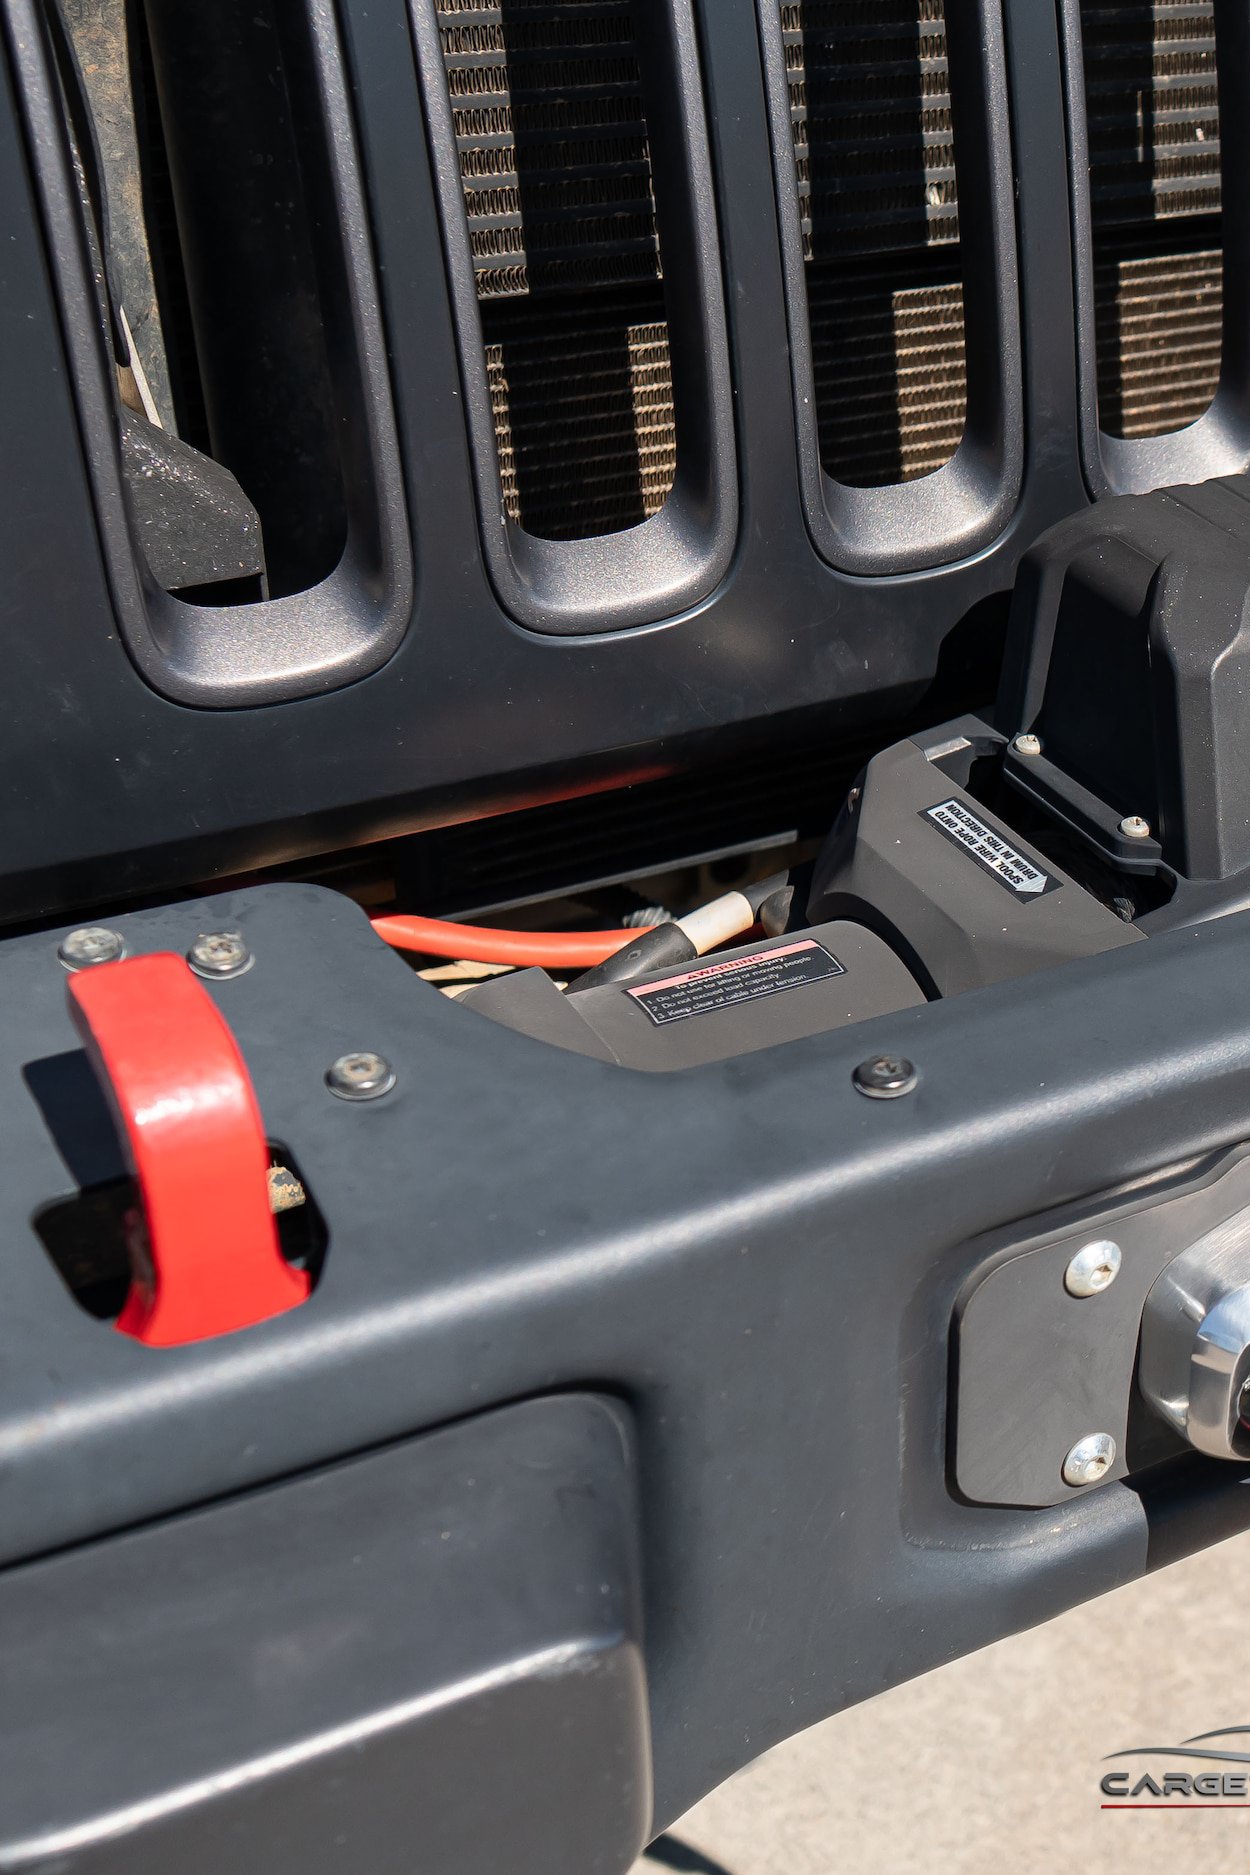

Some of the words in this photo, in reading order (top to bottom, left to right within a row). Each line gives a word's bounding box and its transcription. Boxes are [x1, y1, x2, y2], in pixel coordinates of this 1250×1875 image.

[935, 811, 958, 829] ONTO
[945, 804, 987, 837] DIRECTION
[955, 828, 978, 846] ROPE
[983, 836, 1004, 851] THIS
[974, 845, 997, 863] WIRE
[1001, 849, 1014, 859] IN
[995, 860, 1024, 885] SPOOL
[1011, 858, 1038, 880] DRUM
[688, 974, 723, 987] prevent
[724, 964, 758, 976] serious
[697, 955, 764, 976] WARNING
[686, 986, 703, 994] use
[752, 965, 783, 976] moving
[667, 1007, 692, 1017] Keep
[692, 1001, 714, 1010] clear
[725, 990, 750, 1000] cable
[749, 983, 775, 994] under
[692, 988, 724, 1000] exceed
[724, 983, 744, 992] load
